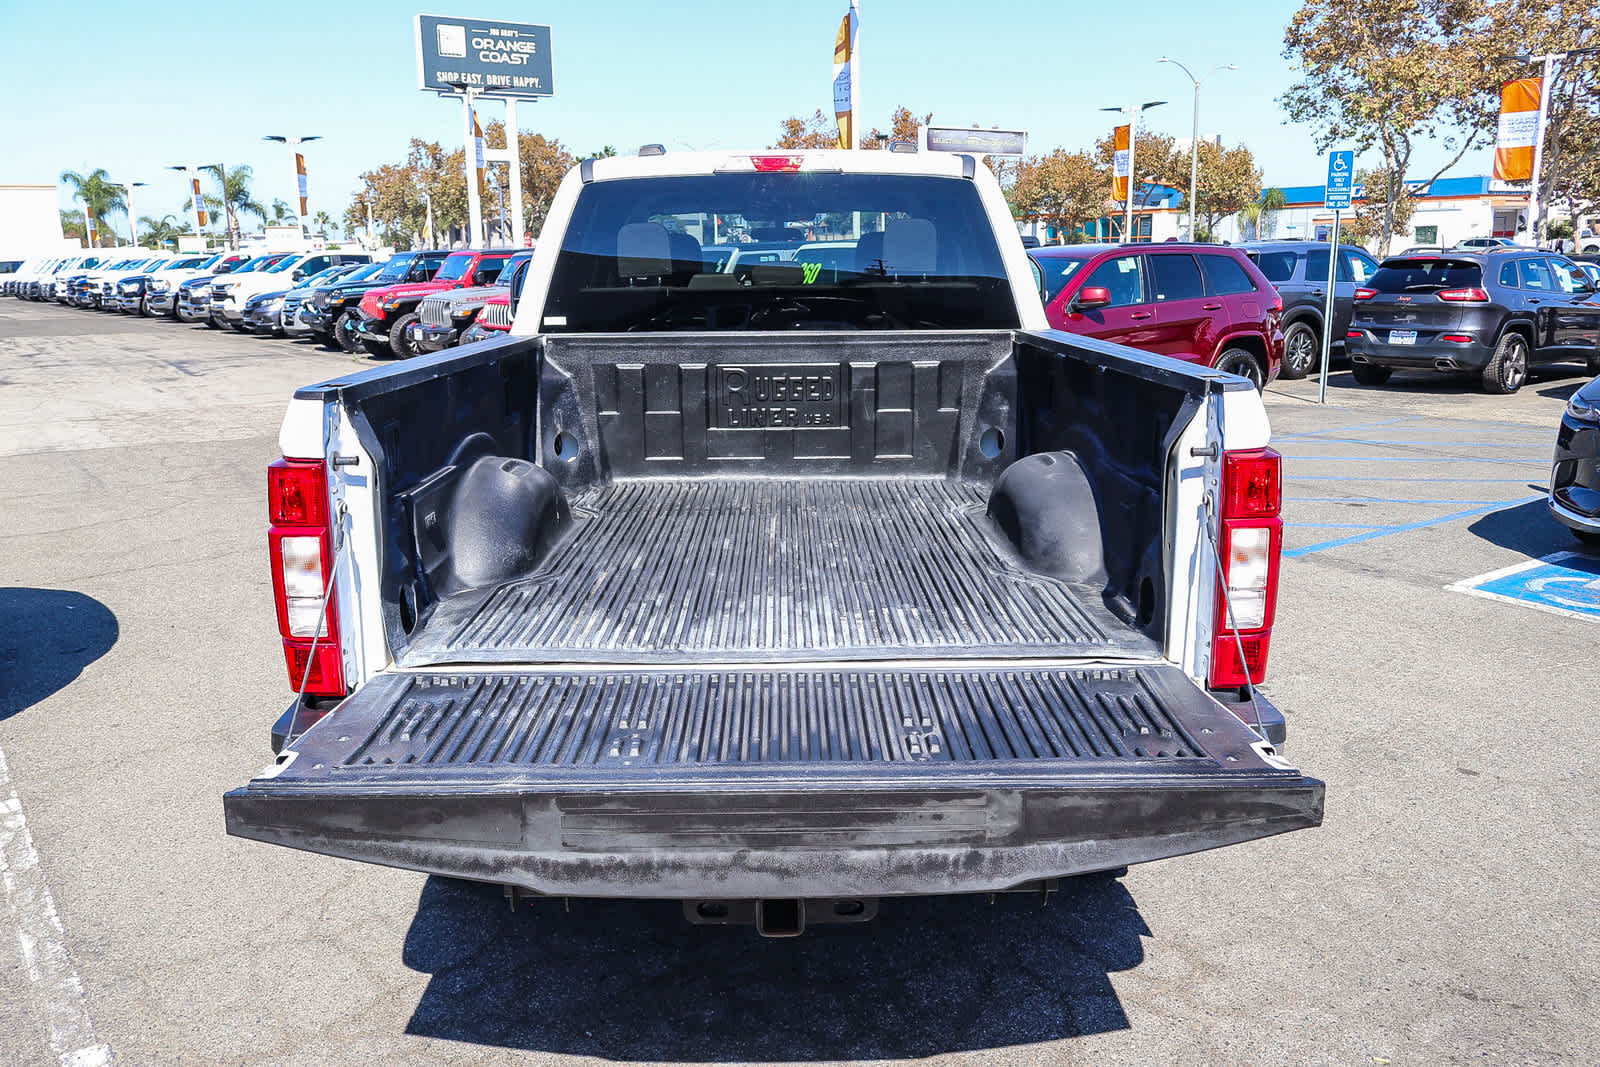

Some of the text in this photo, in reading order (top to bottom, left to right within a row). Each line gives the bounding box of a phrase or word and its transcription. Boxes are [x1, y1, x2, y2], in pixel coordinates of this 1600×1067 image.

[472, 37, 536, 53] ORANGE
[479, 51, 530, 65] COAST
[436, 71, 542, 88] SHOP EASY. DRIVE HAPPY.
[722, 367, 835, 406] RUGGED
[728, 408, 832, 427] LINER USA
